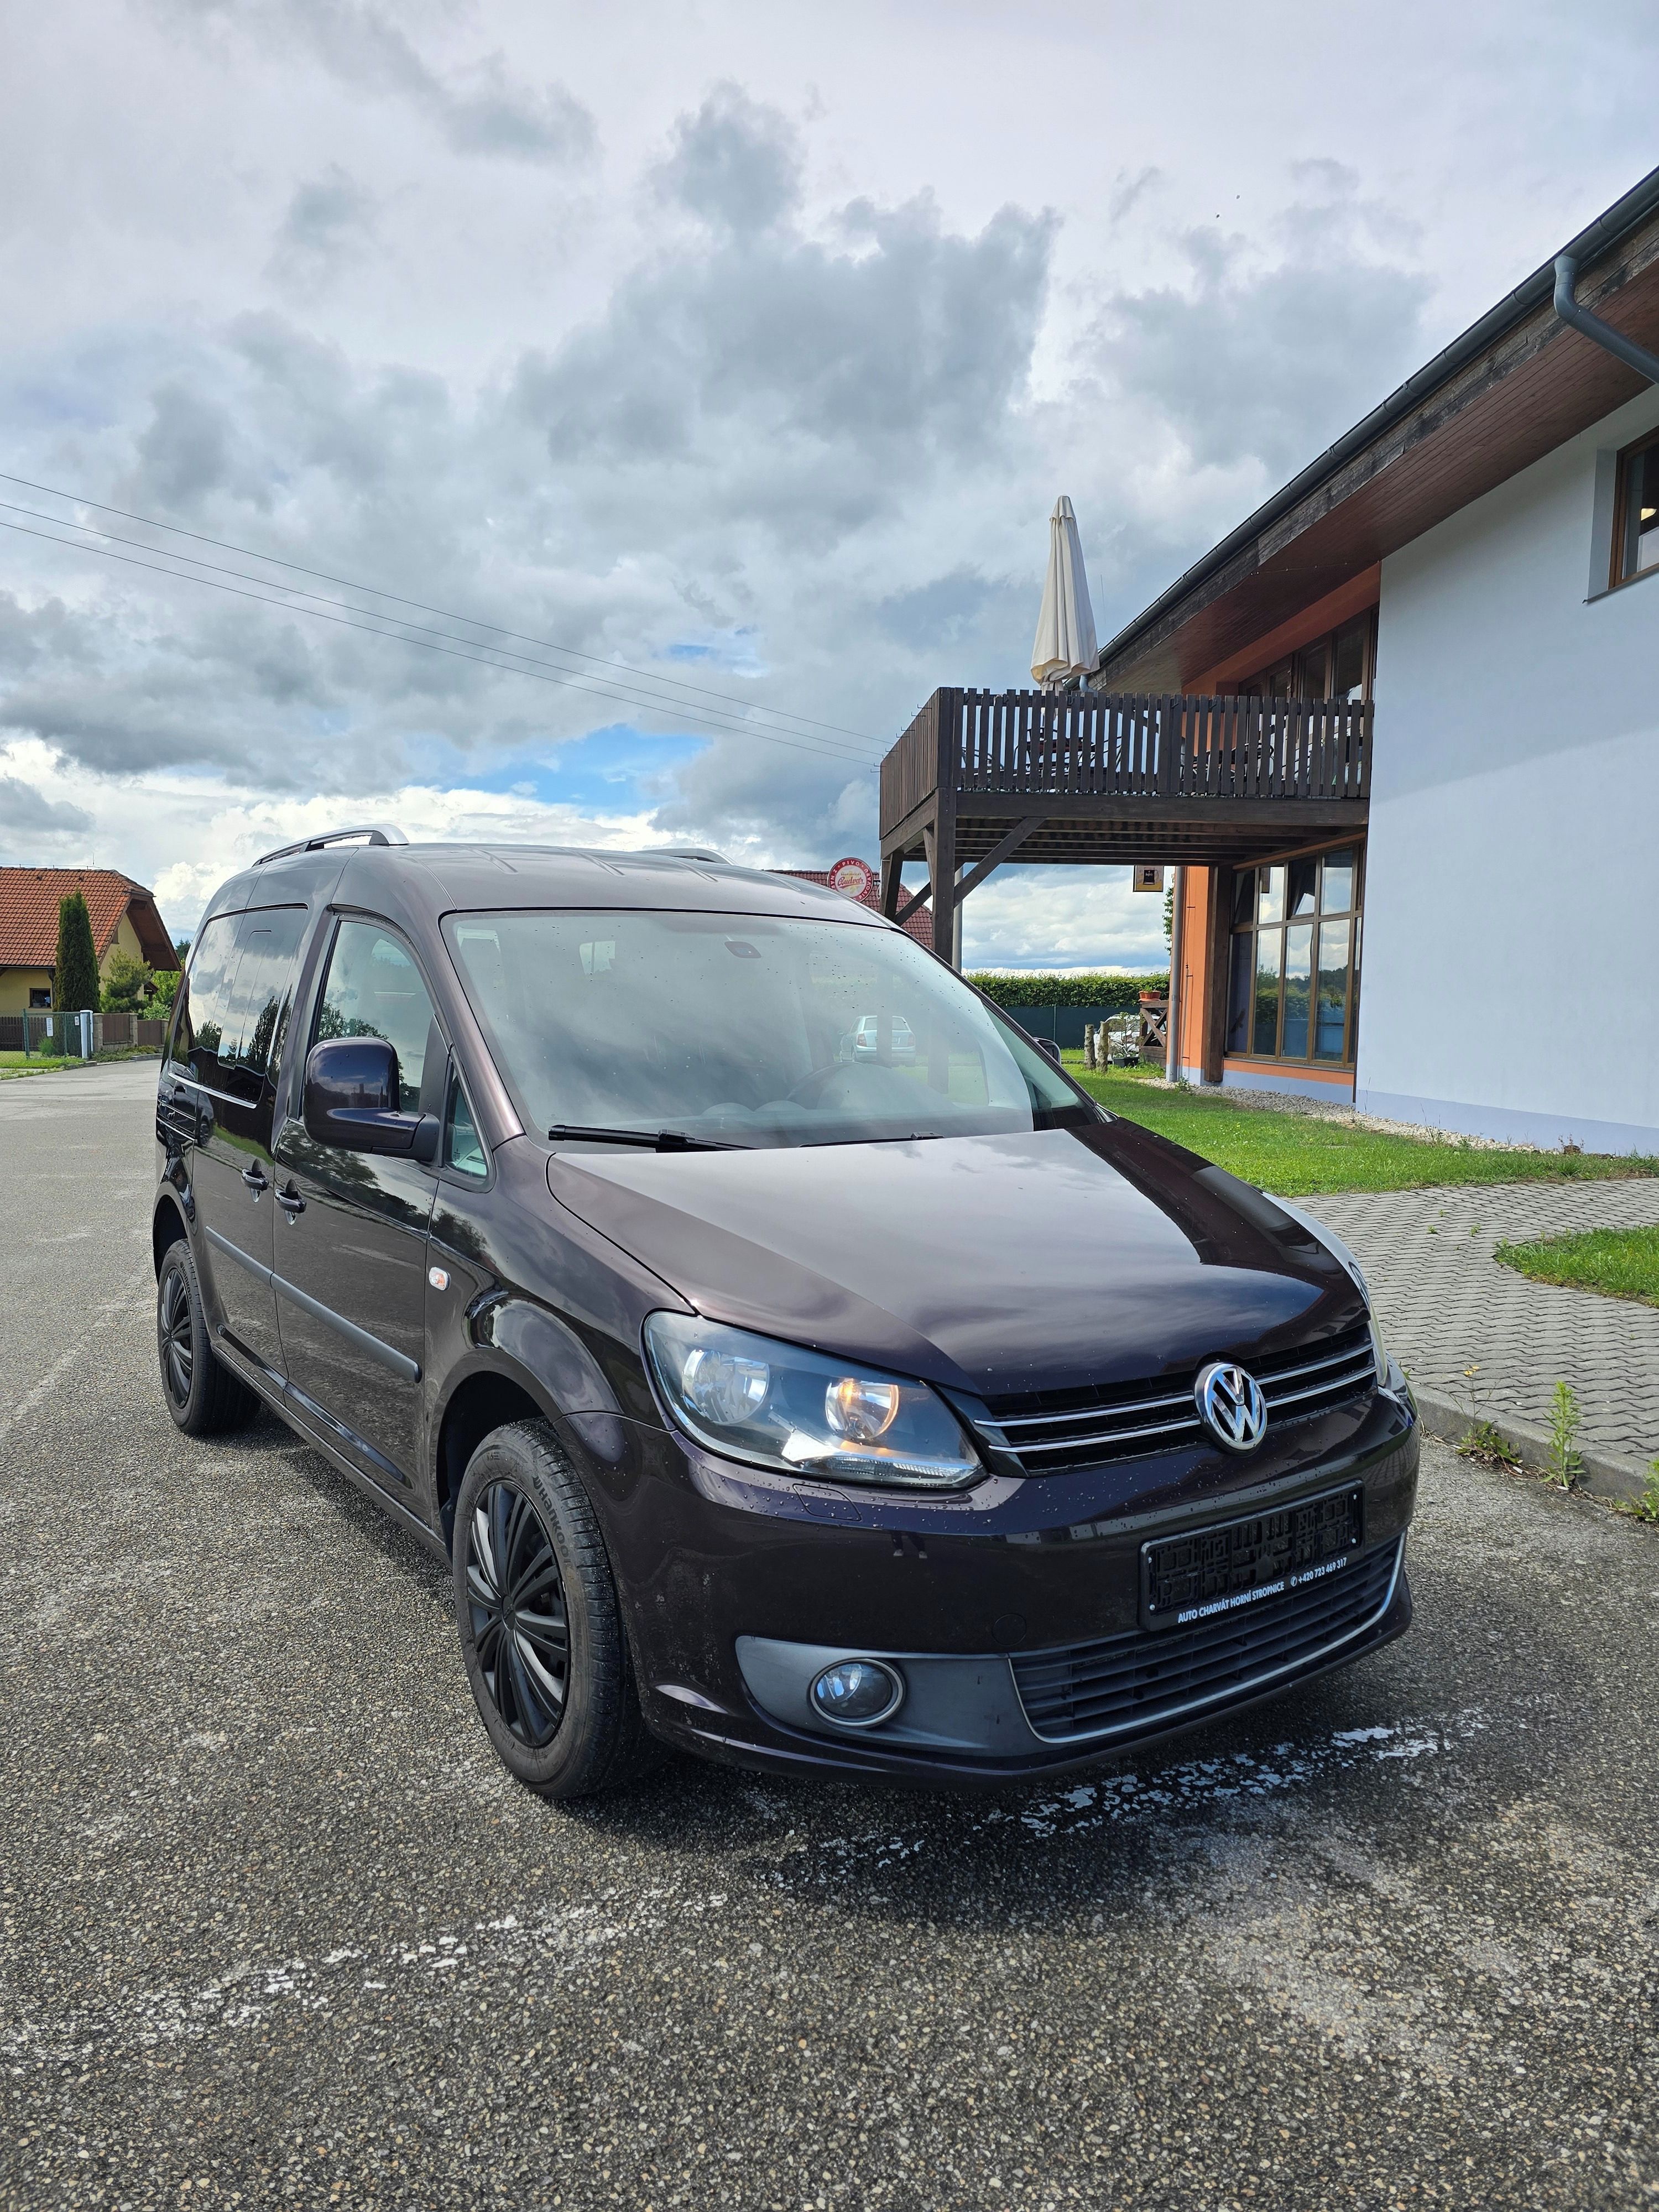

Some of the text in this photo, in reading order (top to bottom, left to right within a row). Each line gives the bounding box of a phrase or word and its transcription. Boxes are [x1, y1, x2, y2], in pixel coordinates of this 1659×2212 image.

[837, 877, 864, 886] Budvar
[1178, 1557, 1347, 1624] AUTO CHARVÁT HORNÍ STROPNICE +420 723 469 317
